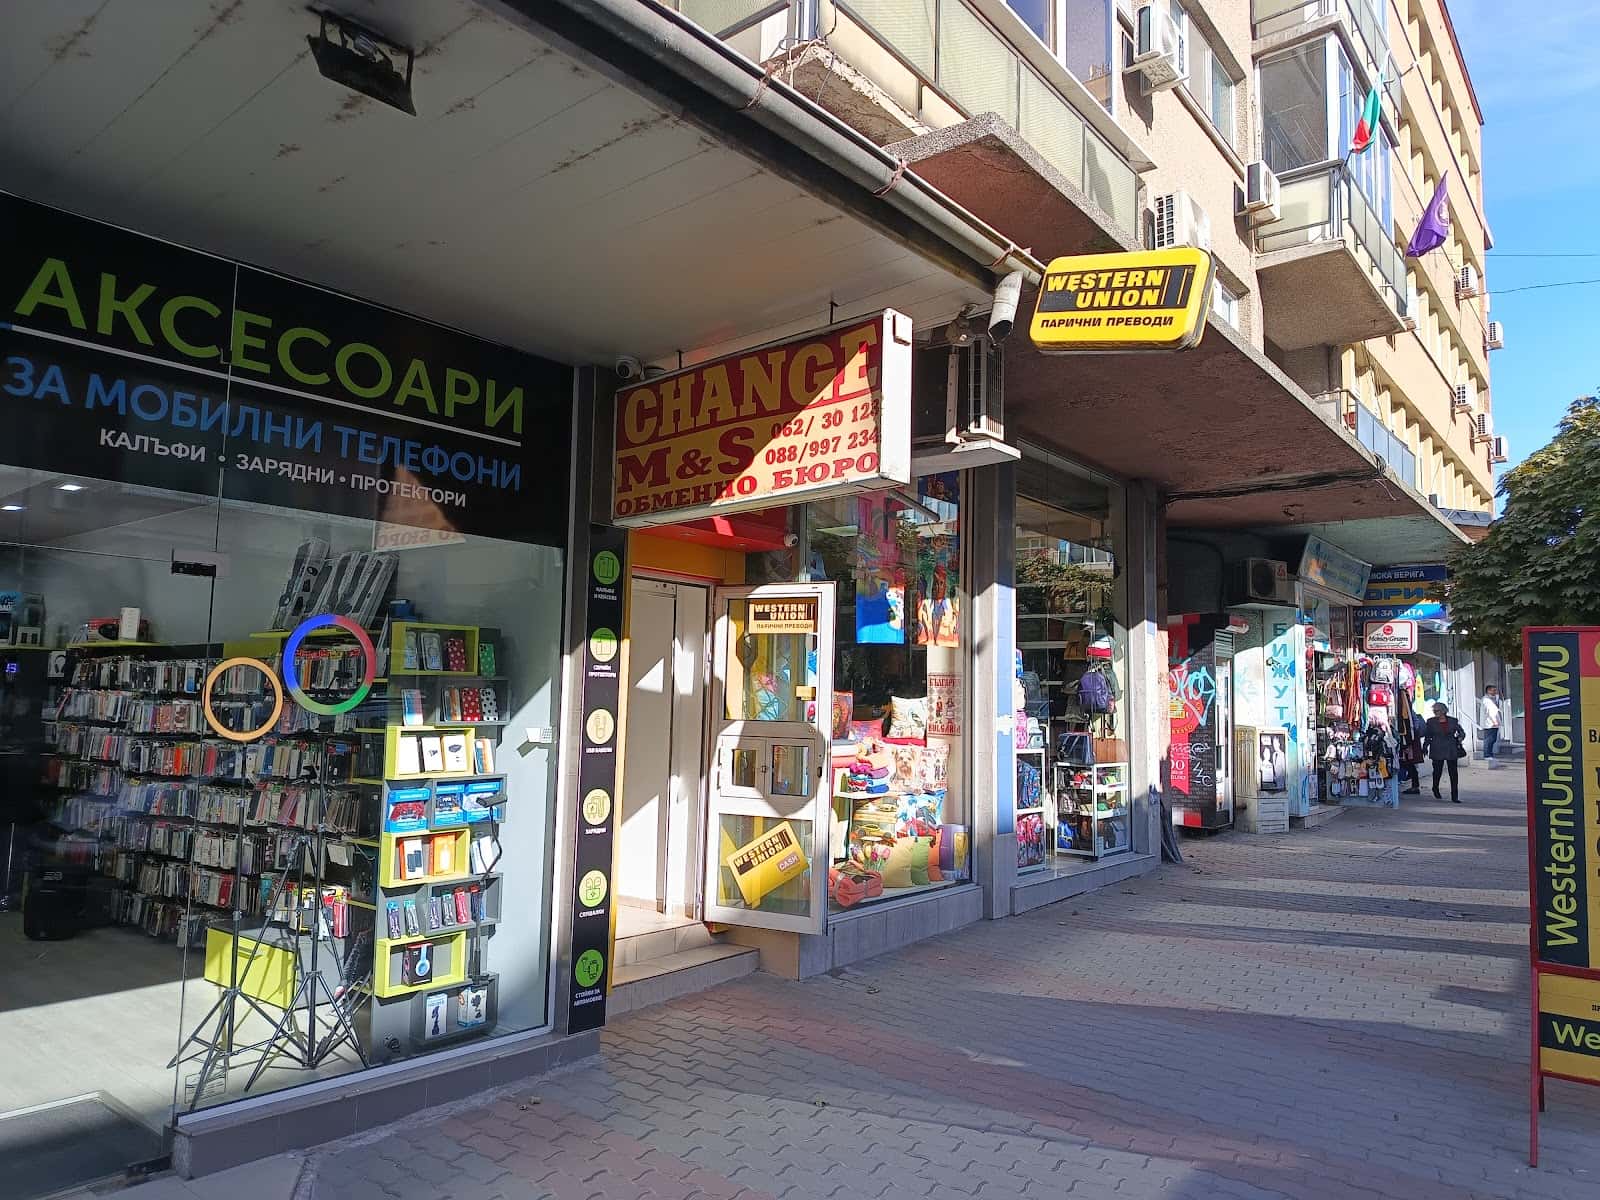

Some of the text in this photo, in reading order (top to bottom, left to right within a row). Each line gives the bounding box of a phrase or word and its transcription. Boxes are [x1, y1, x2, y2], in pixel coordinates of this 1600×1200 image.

[1047, 268, 1165, 292] WESTERN
[1076, 288, 1160, 309] UNION
[1040, 316, 1173, 328] ПАРИЧНИ ПРЕВОДИ
[14, 257, 524, 434] АКСЕСОАРИ
[624, 323, 878, 444] CHANGE
[2, 356, 521, 492] ЗА МОБИЛНИ ТЕЛЕФОНИ
[821, 409, 844, 430] 30
[765, 426, 880, 465] 088/997 234
[99, 427, 467, 508] КАЛЪФИ ЗАРЯДНИ ПРОТЕКТОРИ
[616, 451, 880, 516] ОБМЕННО БЮРО
[754, 603, 806, 613] WESTERN
[770, 612, 806, 620] UNION
[733, 834, 781, 868] WESTERN
[751, 842, 783, 867] UNION
[779, 854, 800, 871] CASH
